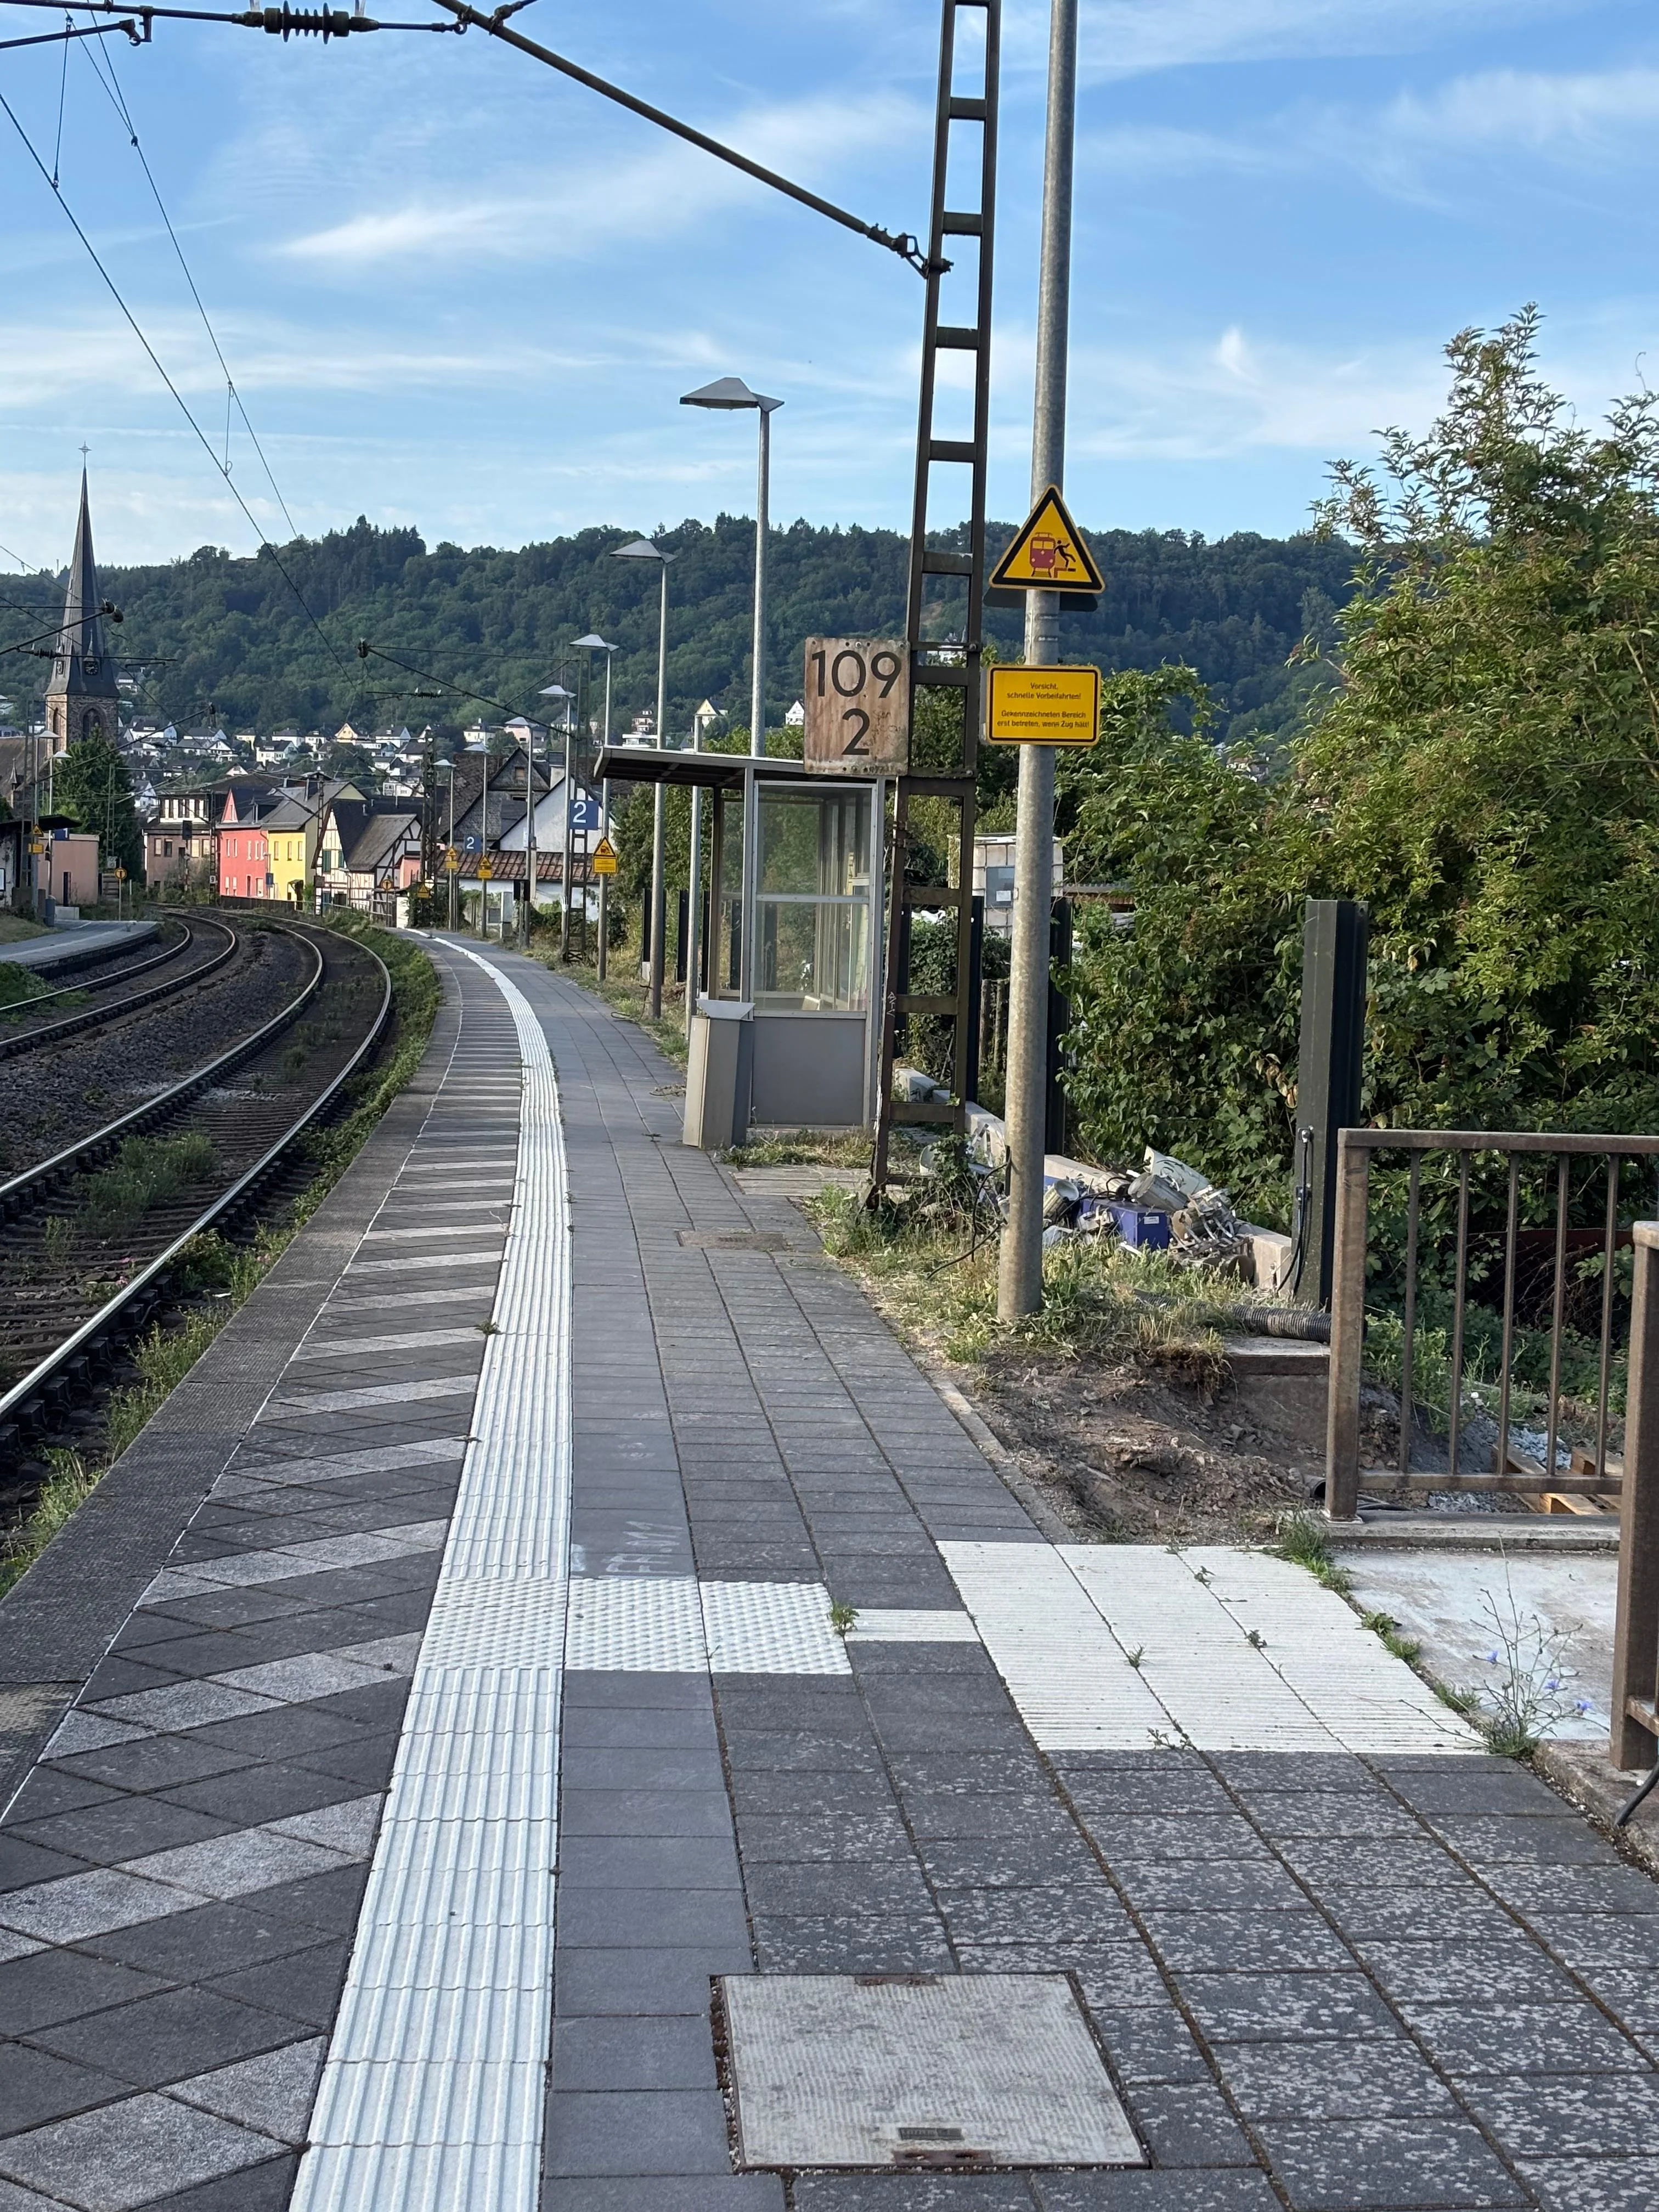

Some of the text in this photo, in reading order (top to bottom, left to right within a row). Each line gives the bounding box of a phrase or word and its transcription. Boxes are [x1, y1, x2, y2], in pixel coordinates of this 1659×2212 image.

[812, 650, 901, 698] 109
[1001, 710, 1060, 718] Gekennzeichneten
[841, 708, 870, 755] 2
[1060, 721, 1074, 729] Zug
[573, 801, 586, 823] 2
[466, 836, 475, 849] 2
